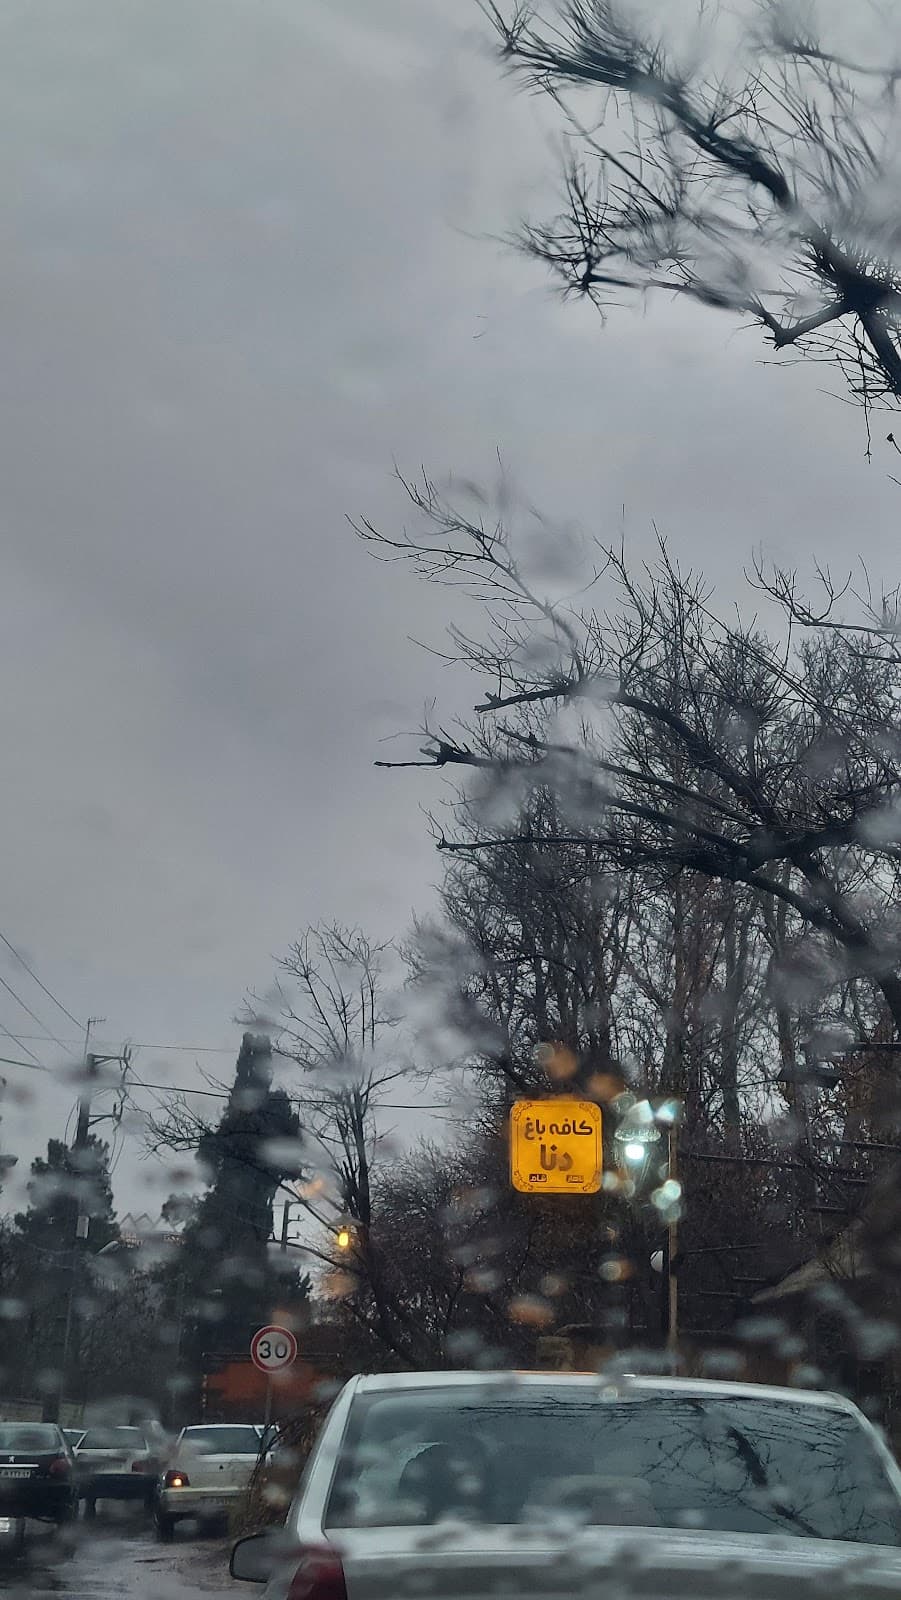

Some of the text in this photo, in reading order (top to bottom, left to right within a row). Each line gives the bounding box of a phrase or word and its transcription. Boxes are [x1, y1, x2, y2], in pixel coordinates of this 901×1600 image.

[524, 1117, 593, 1140] کافه باغ
[540, 1144, 574, 1171] دنا
[259, 1340, 288, 1359] 30
